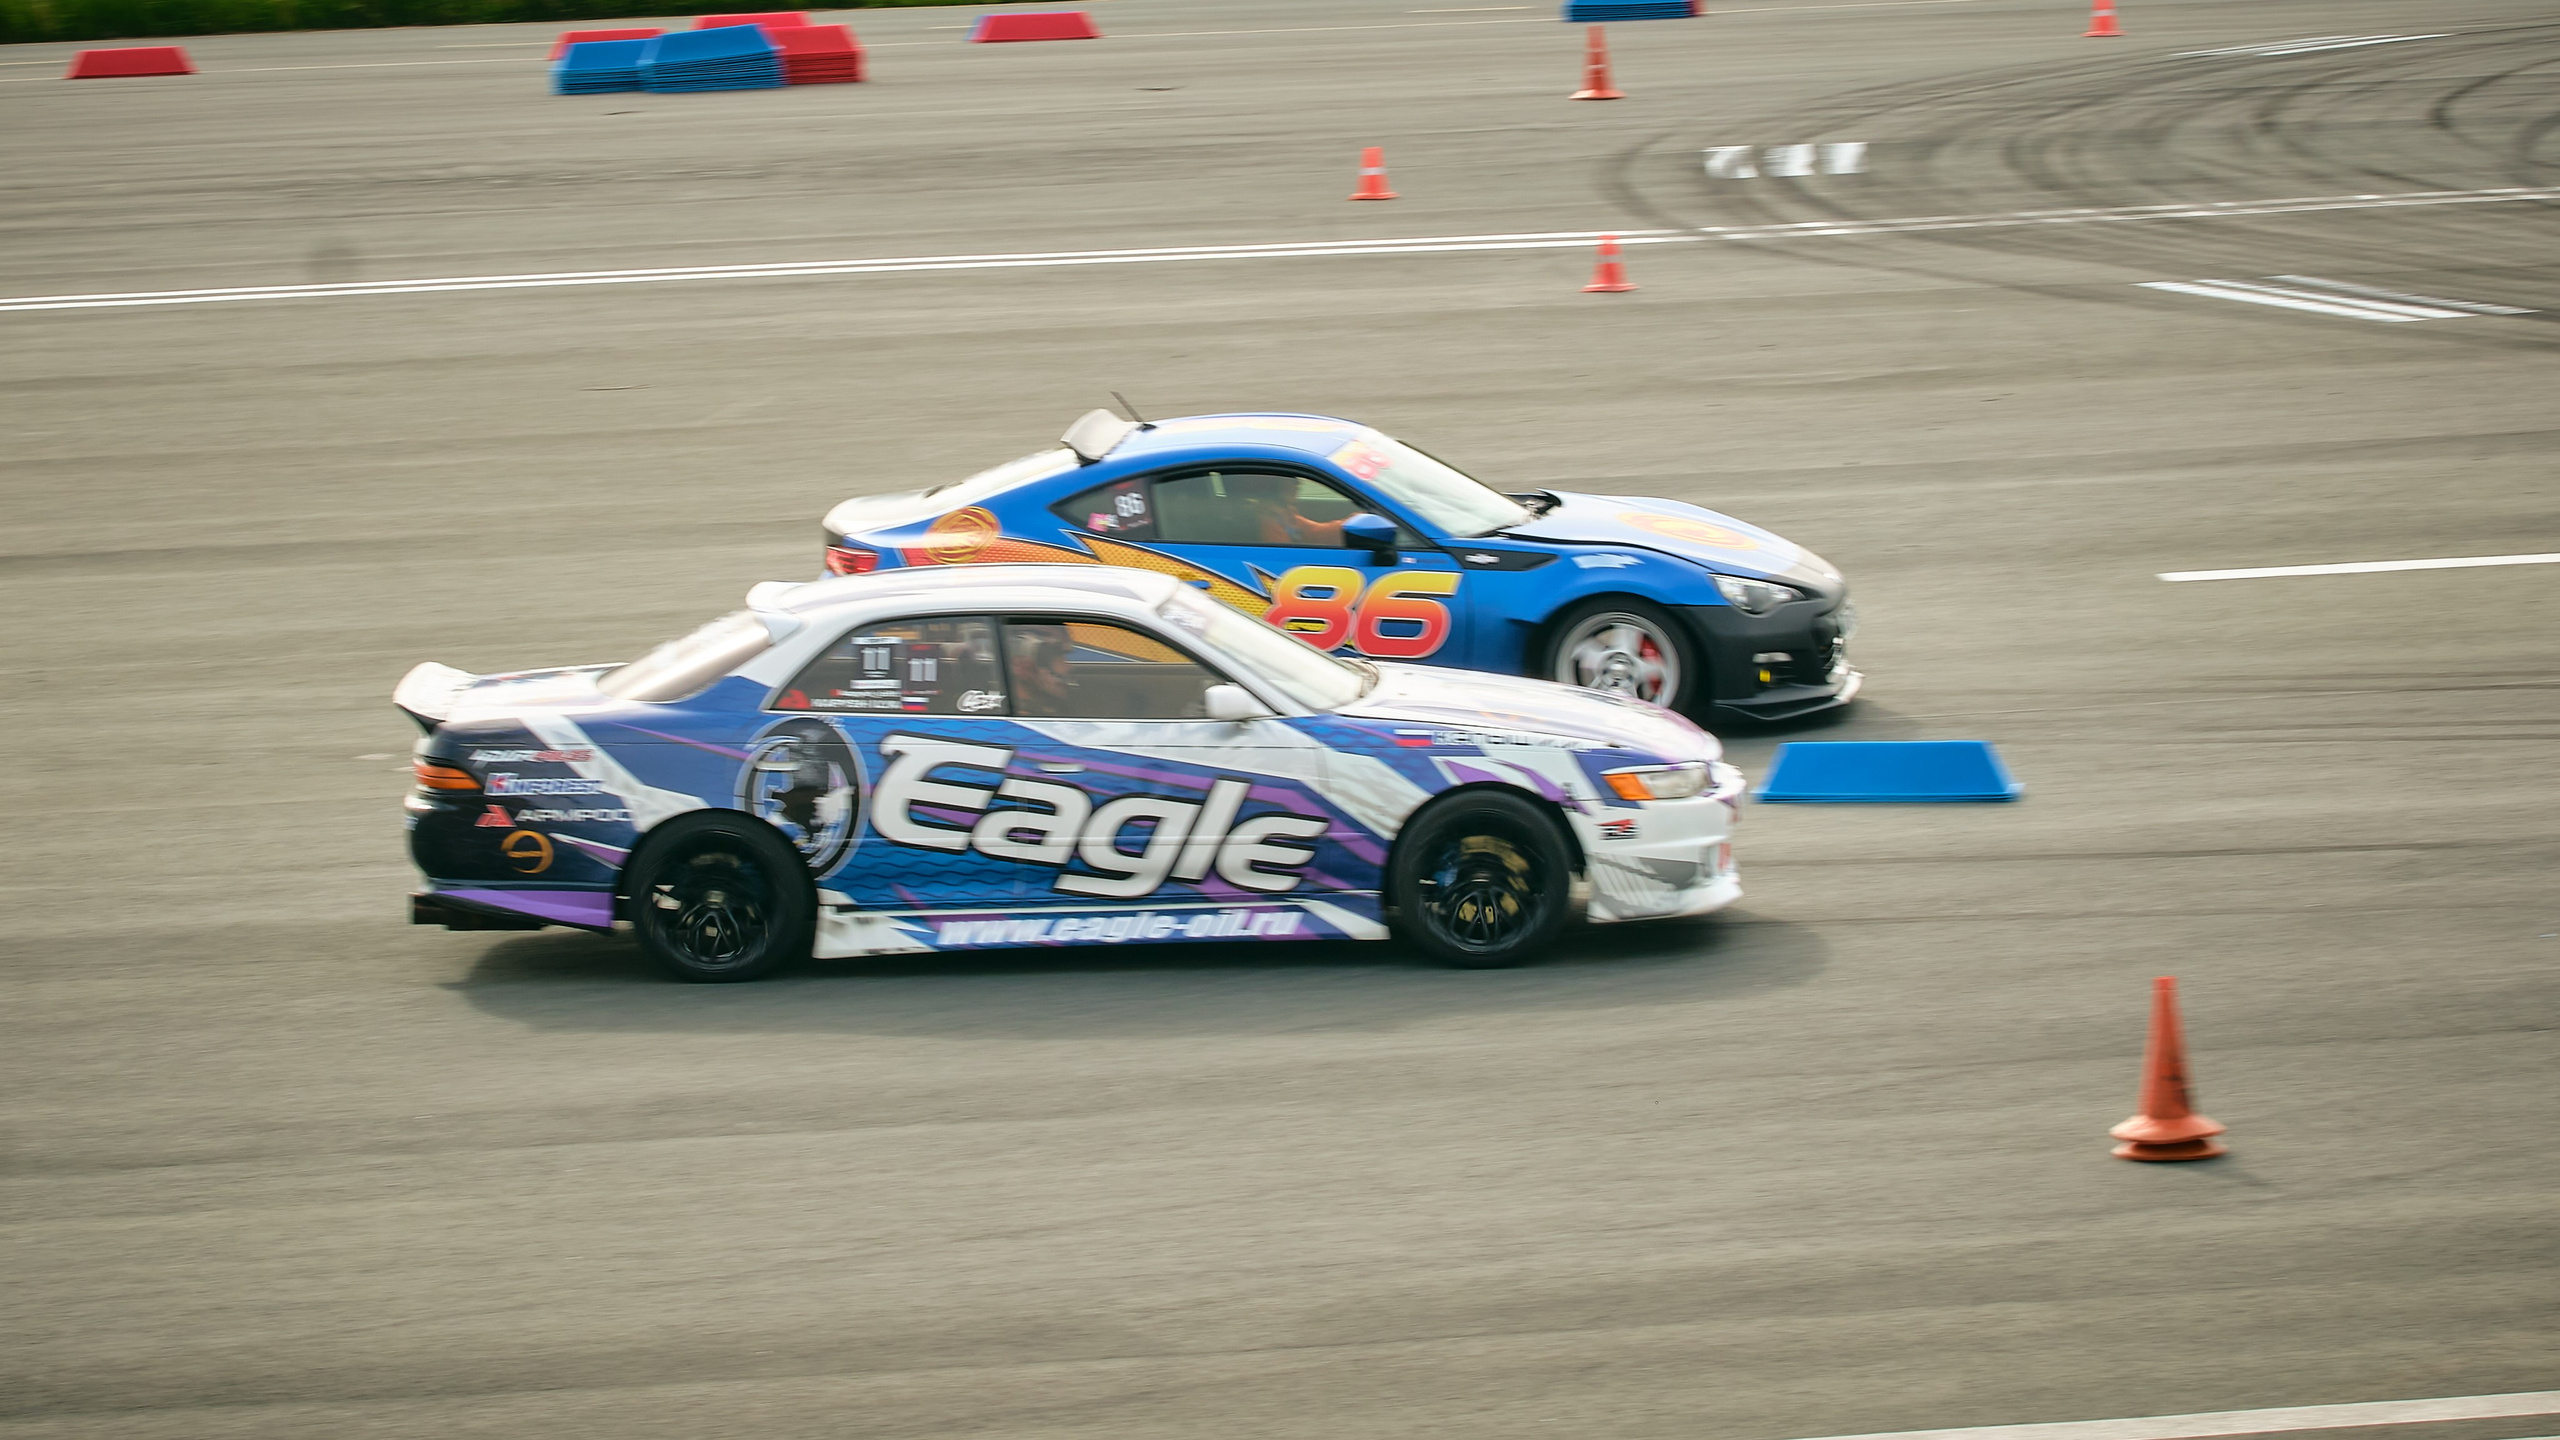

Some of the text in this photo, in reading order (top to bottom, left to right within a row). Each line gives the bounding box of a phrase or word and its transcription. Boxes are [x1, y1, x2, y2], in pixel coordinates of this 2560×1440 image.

[1114, 492, 1146, 518] 86
[1264, 565, 1462, 658] 86
[870, 731, 1329, 898] Eagle
[937, 909, 1304, 945] www.eagle-oil.ru
